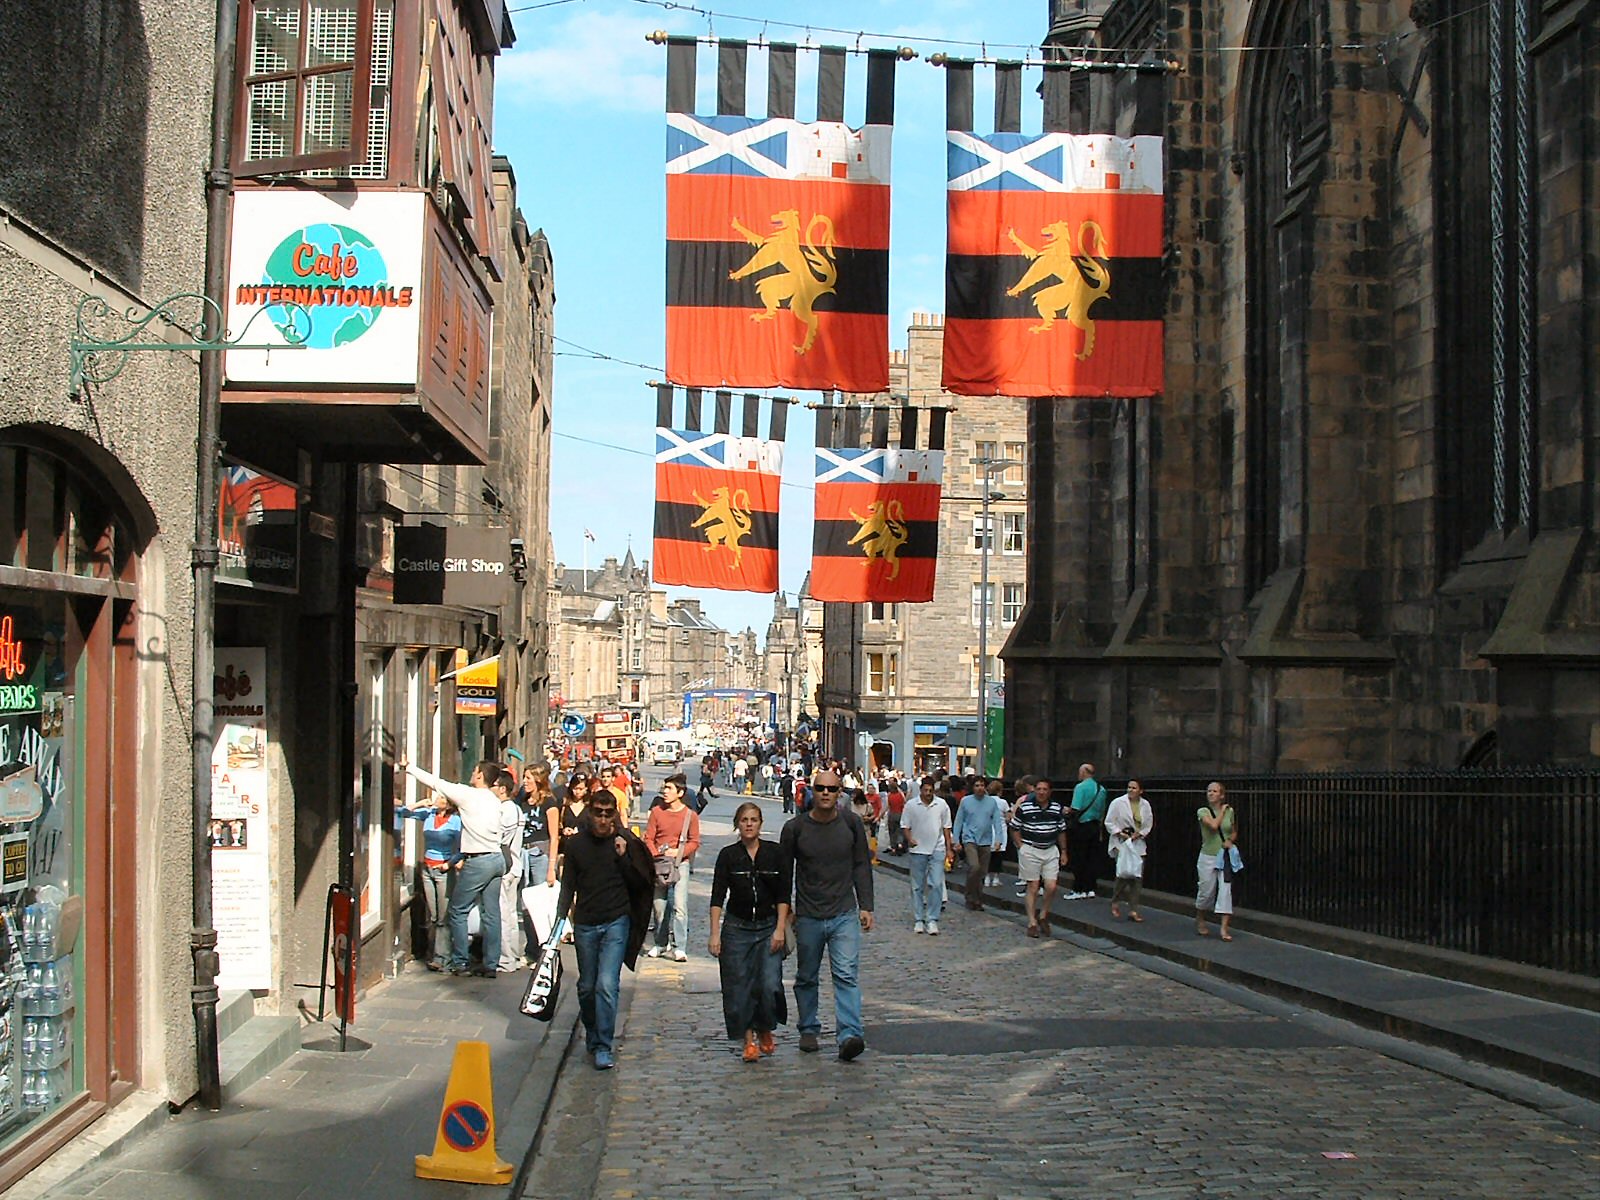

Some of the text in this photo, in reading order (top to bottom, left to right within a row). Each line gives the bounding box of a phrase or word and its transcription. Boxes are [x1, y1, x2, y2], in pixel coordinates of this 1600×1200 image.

[293, 243, 358, 281] Café
[236, 284, 413, 308] INTERNATIONALE
[399, 558, 504, 575] Castle Gift Shop
[213, 664, 252, 701] afé
[458, 688, 496, 697] GOLD
[213, 705, 264, 717] ATIONALE
[211, 765, 260, 815] TAIRS
